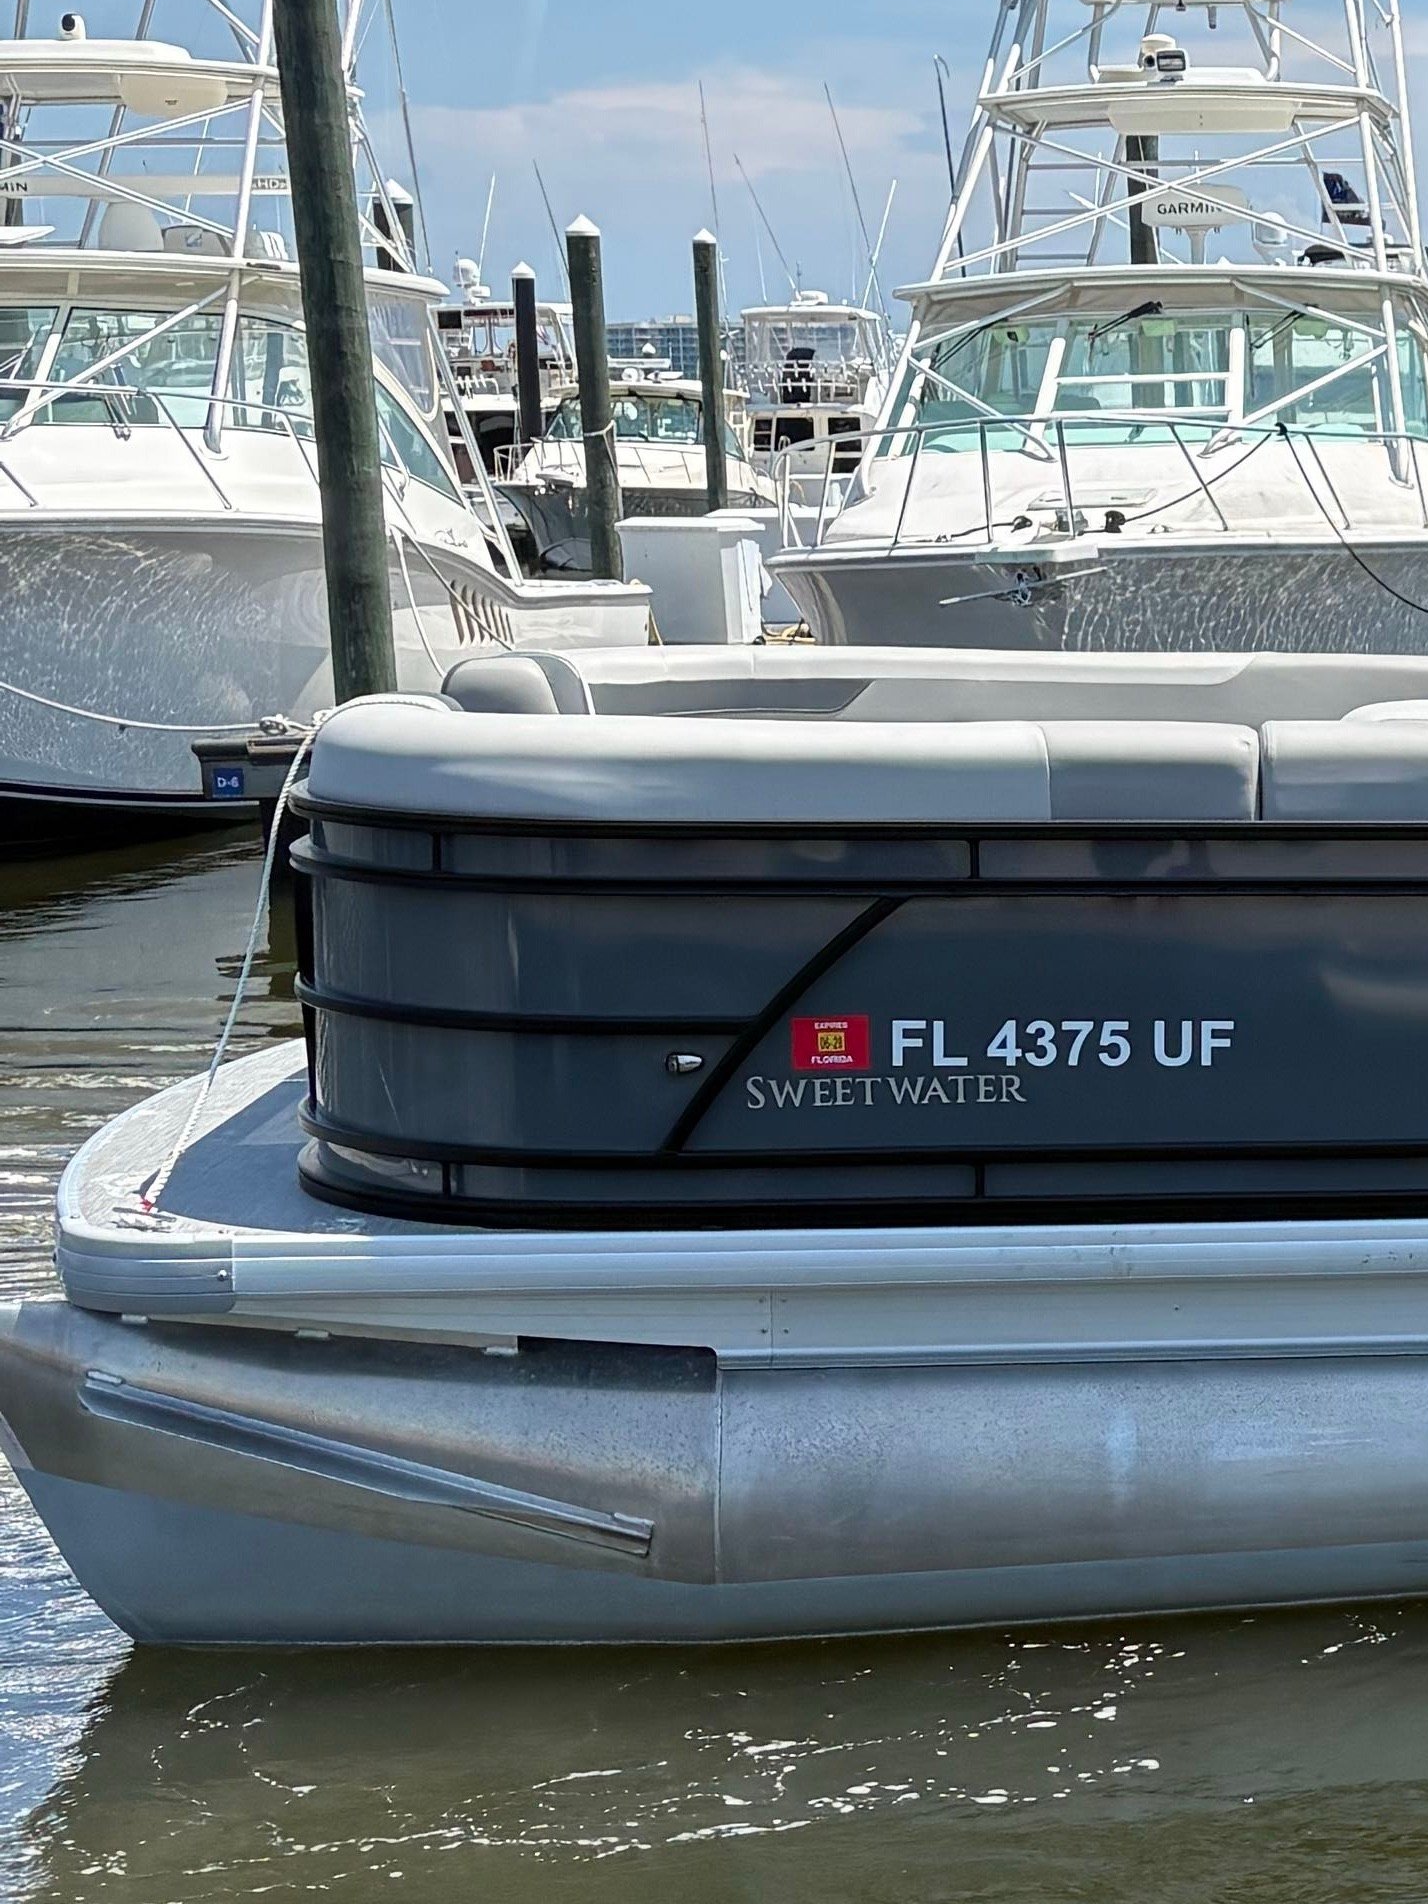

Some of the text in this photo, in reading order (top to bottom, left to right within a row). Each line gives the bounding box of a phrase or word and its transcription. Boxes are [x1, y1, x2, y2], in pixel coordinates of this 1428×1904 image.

[891, 1019, 1235, 1068] FL 4375 UF
[811, 1055, 854, 1065] FLORIDA
